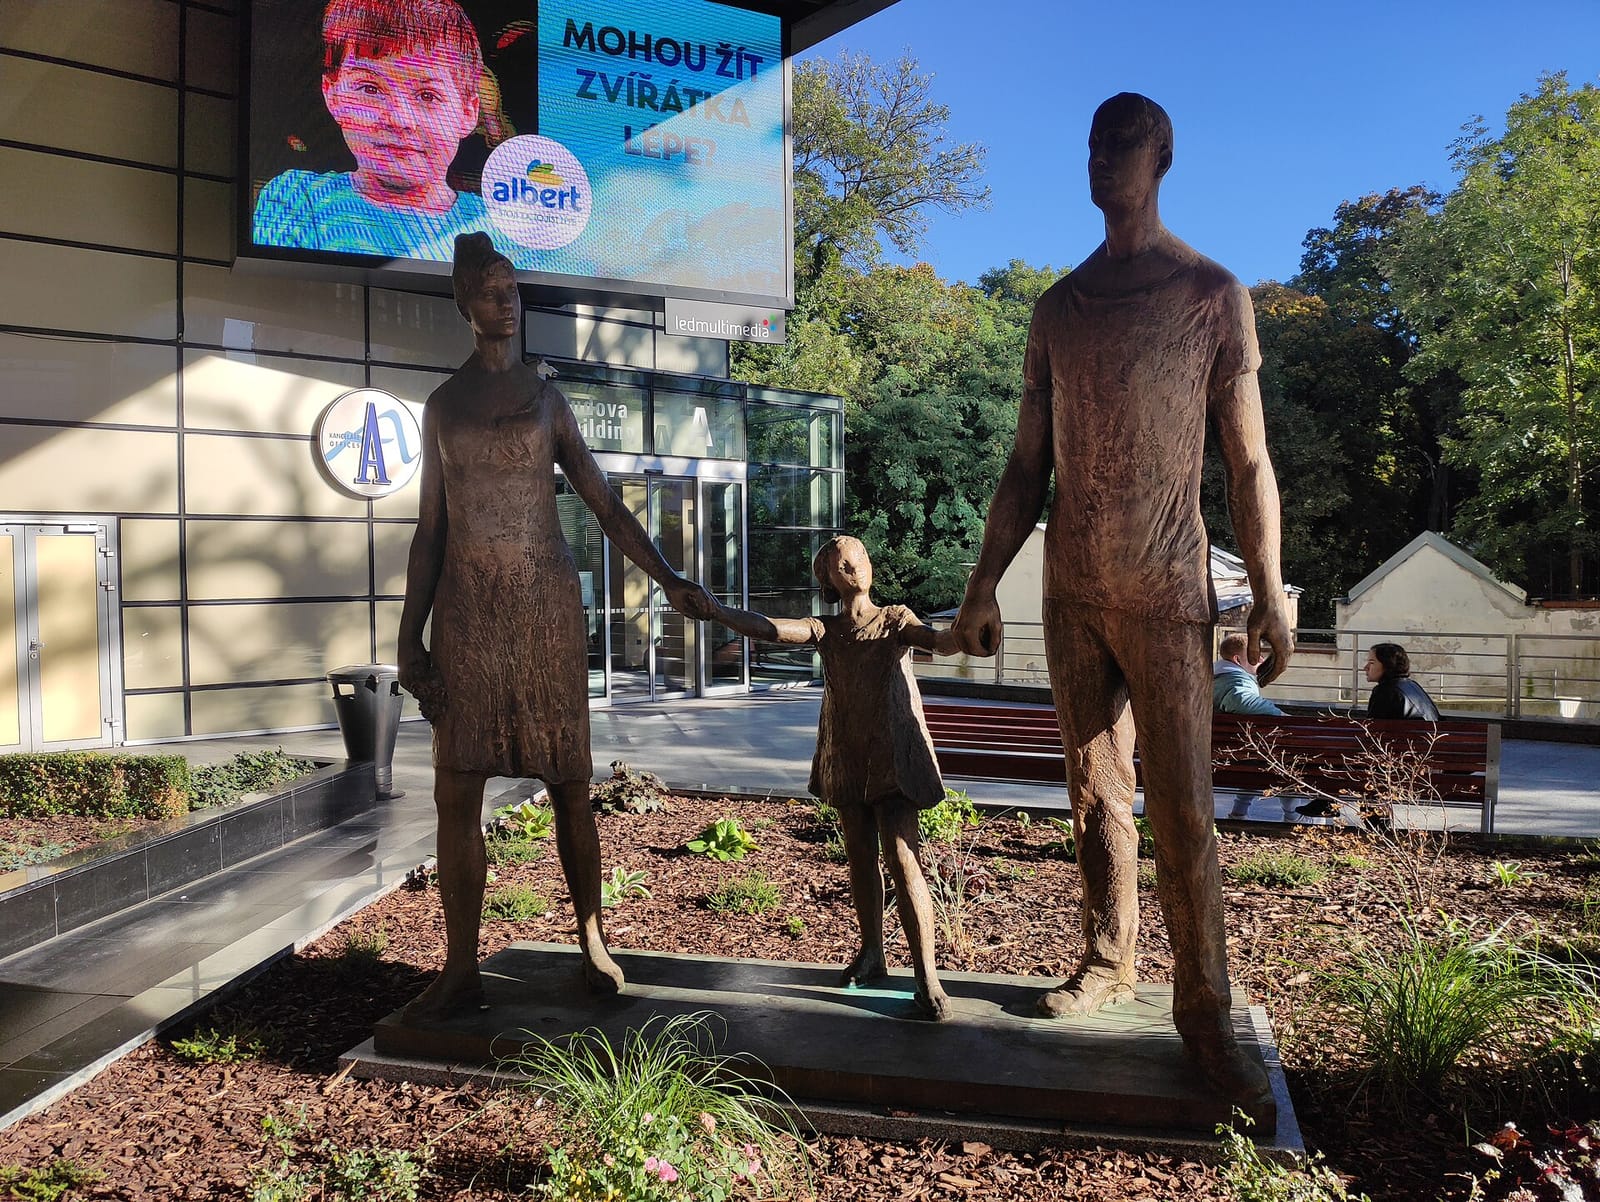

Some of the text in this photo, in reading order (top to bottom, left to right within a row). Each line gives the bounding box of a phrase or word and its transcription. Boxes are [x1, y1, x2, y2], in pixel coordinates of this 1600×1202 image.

[563, 18, 764, 82] MOHOU ŽÍT
[576, 68, 751, 129] ZVÍŘÁTKA
[492, 177, 582, 212] albert
[675, 315, 769, 338] ledmultimedia
